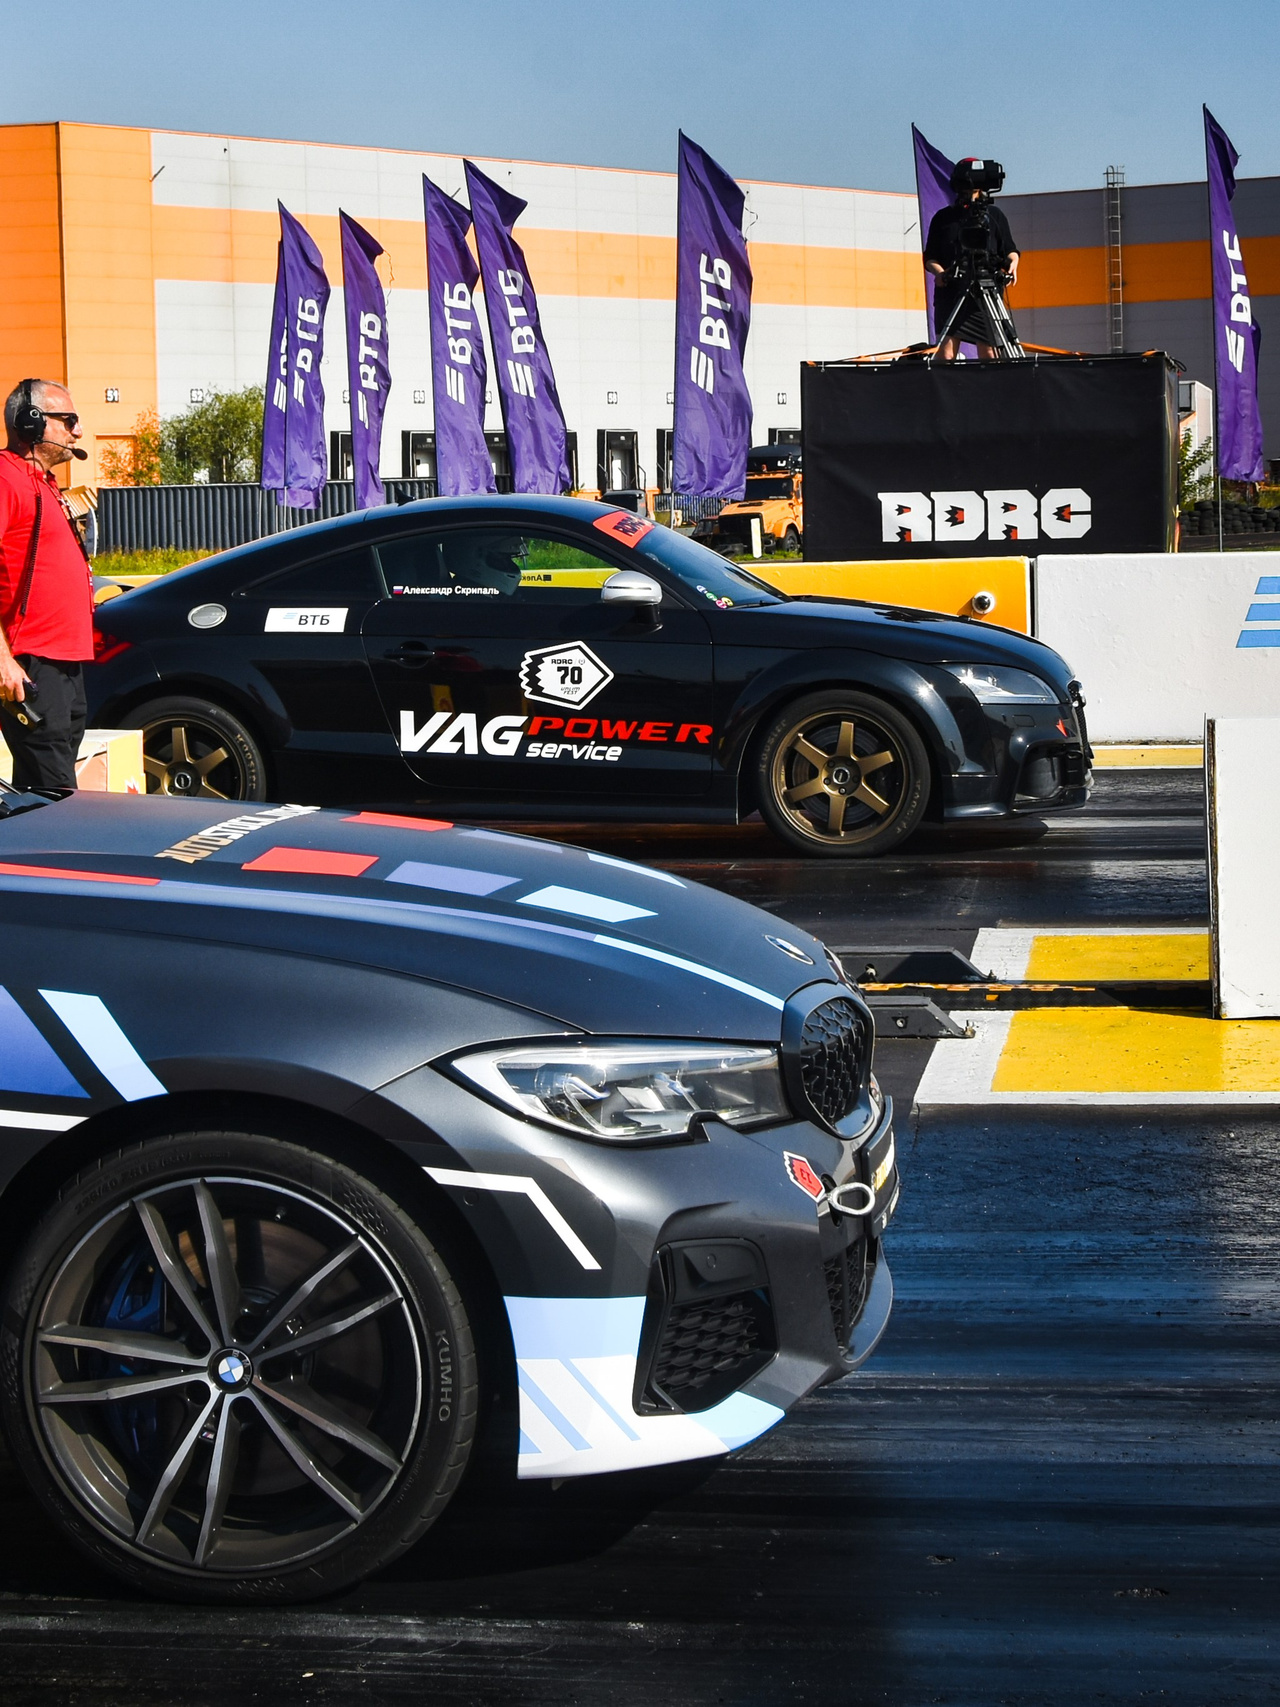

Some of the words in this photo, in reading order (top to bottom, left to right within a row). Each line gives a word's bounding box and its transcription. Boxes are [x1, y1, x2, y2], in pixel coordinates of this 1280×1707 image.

[444, 281, 472, 365] ВТБ
[498, 269, 536, 354] ВТБ
[699, 253, 732, 350] ВТБ
[877, 487, 1092, 543] RDRC
[403, 585, 453, 596] Александр
[454, 585, 500, 596] Скрипаль
[298, 614, 331, 626] ВТБ
[557, 666, 583, 685] 70
[400, 710, 529, 757] VAG
[527, 715, 714, 744] POWER
[525, 740, 624, 762] service
[434, 1329, 453, 1422] KUMHO
